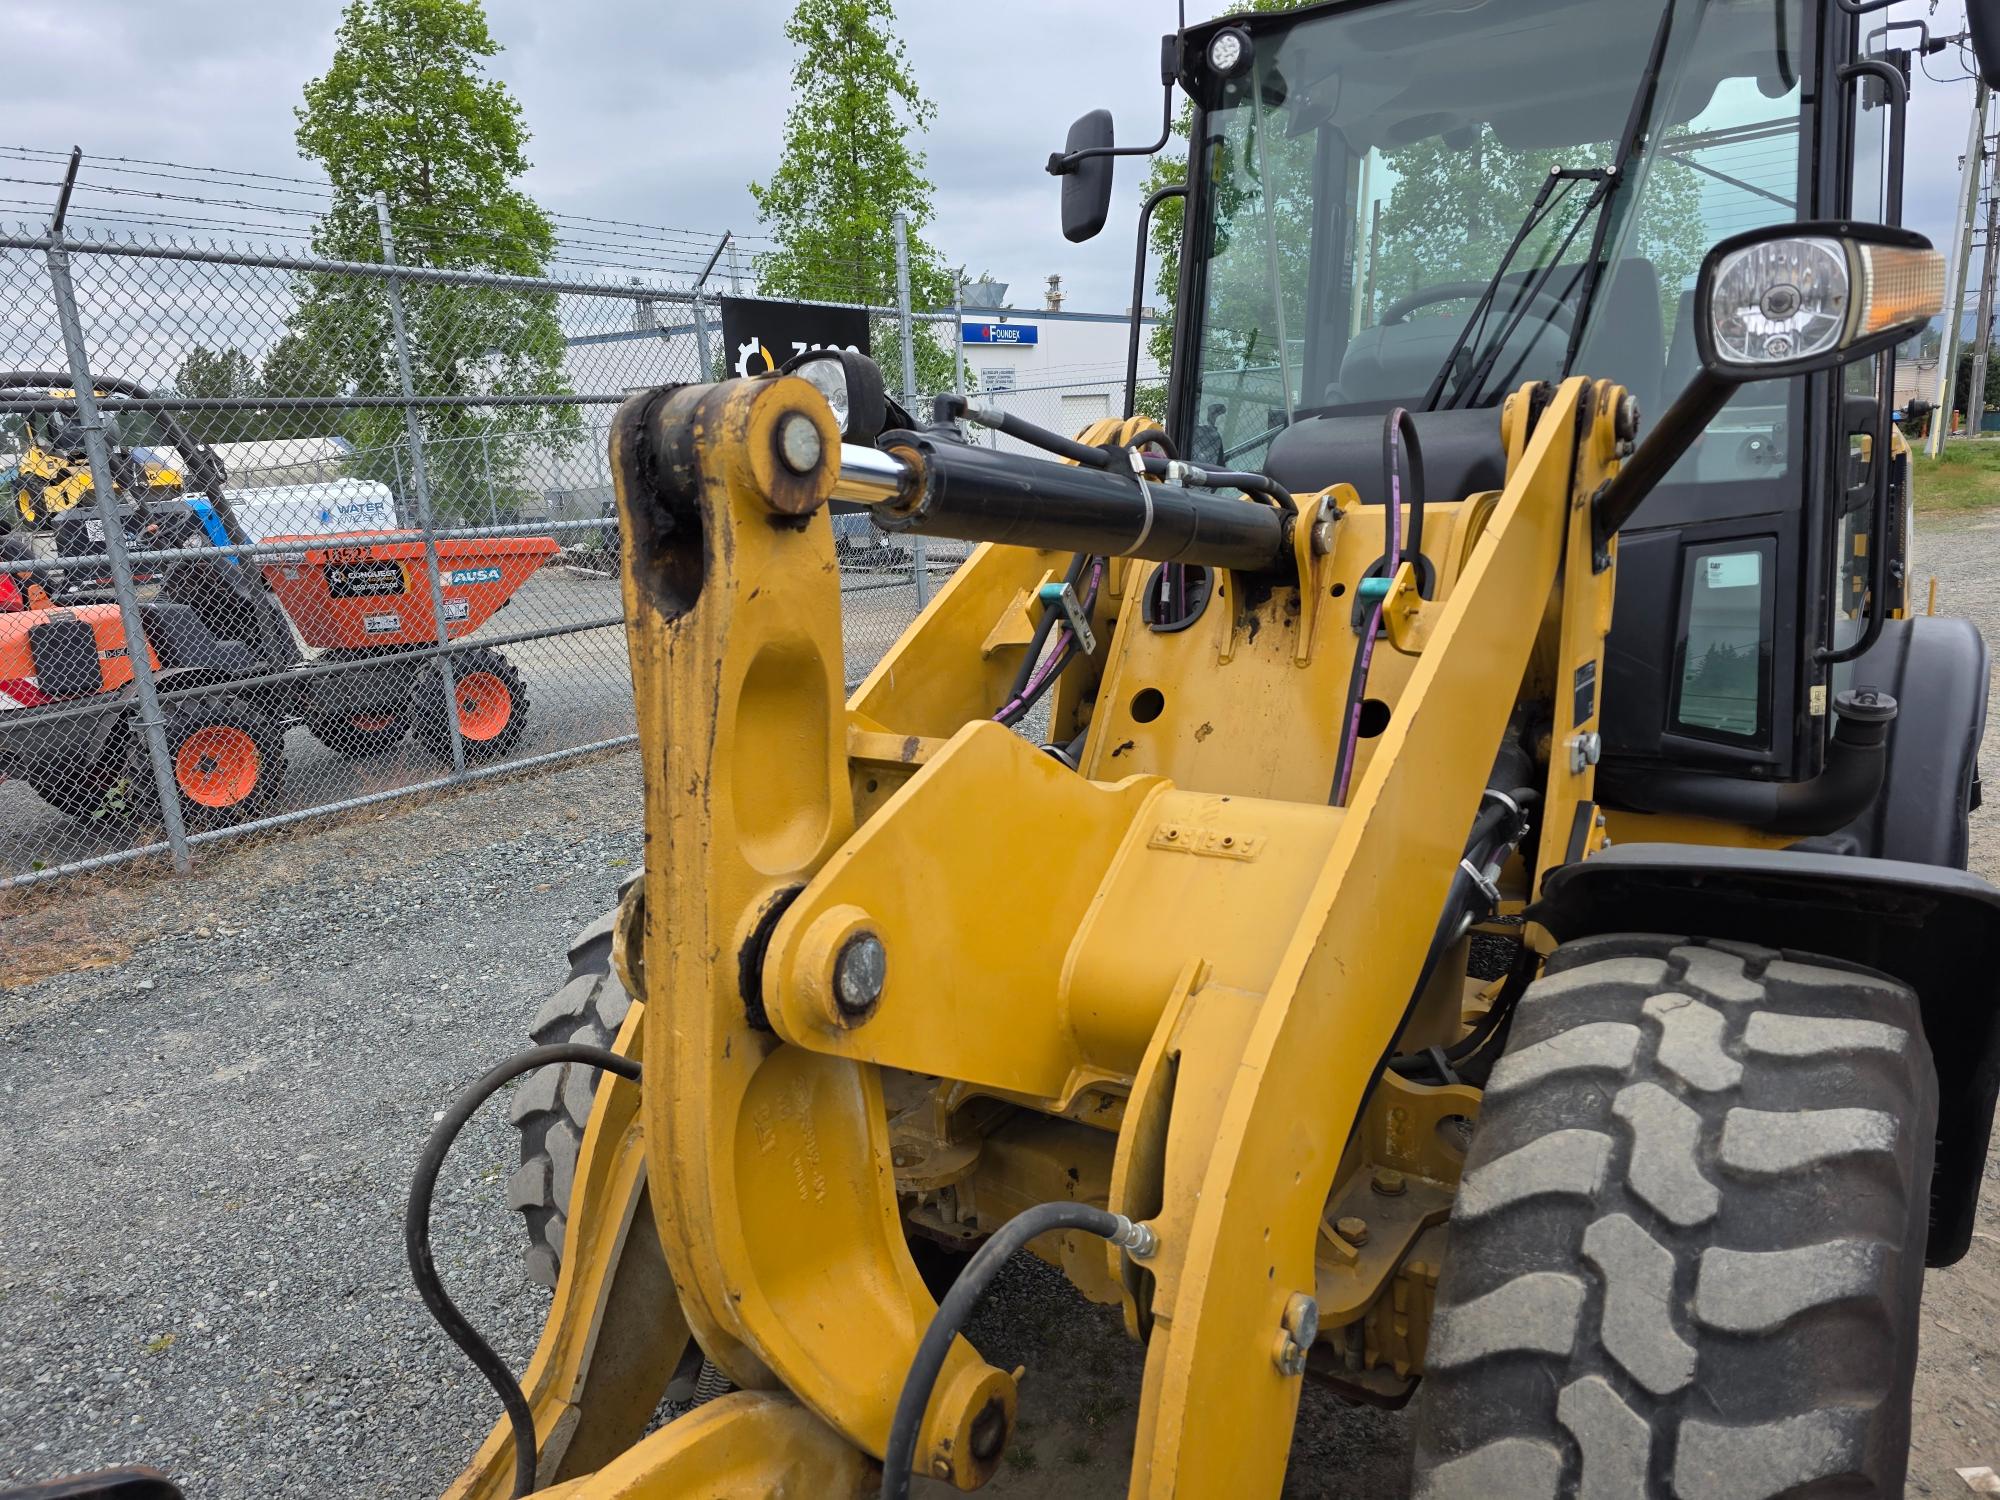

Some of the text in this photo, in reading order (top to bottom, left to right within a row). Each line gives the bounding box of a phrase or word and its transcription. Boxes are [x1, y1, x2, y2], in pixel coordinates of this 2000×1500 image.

[337, 502, 384, 513] WATER
[348, 569, 397, 579] CONQUEST
[453, 569, 500, 583] AUSA
